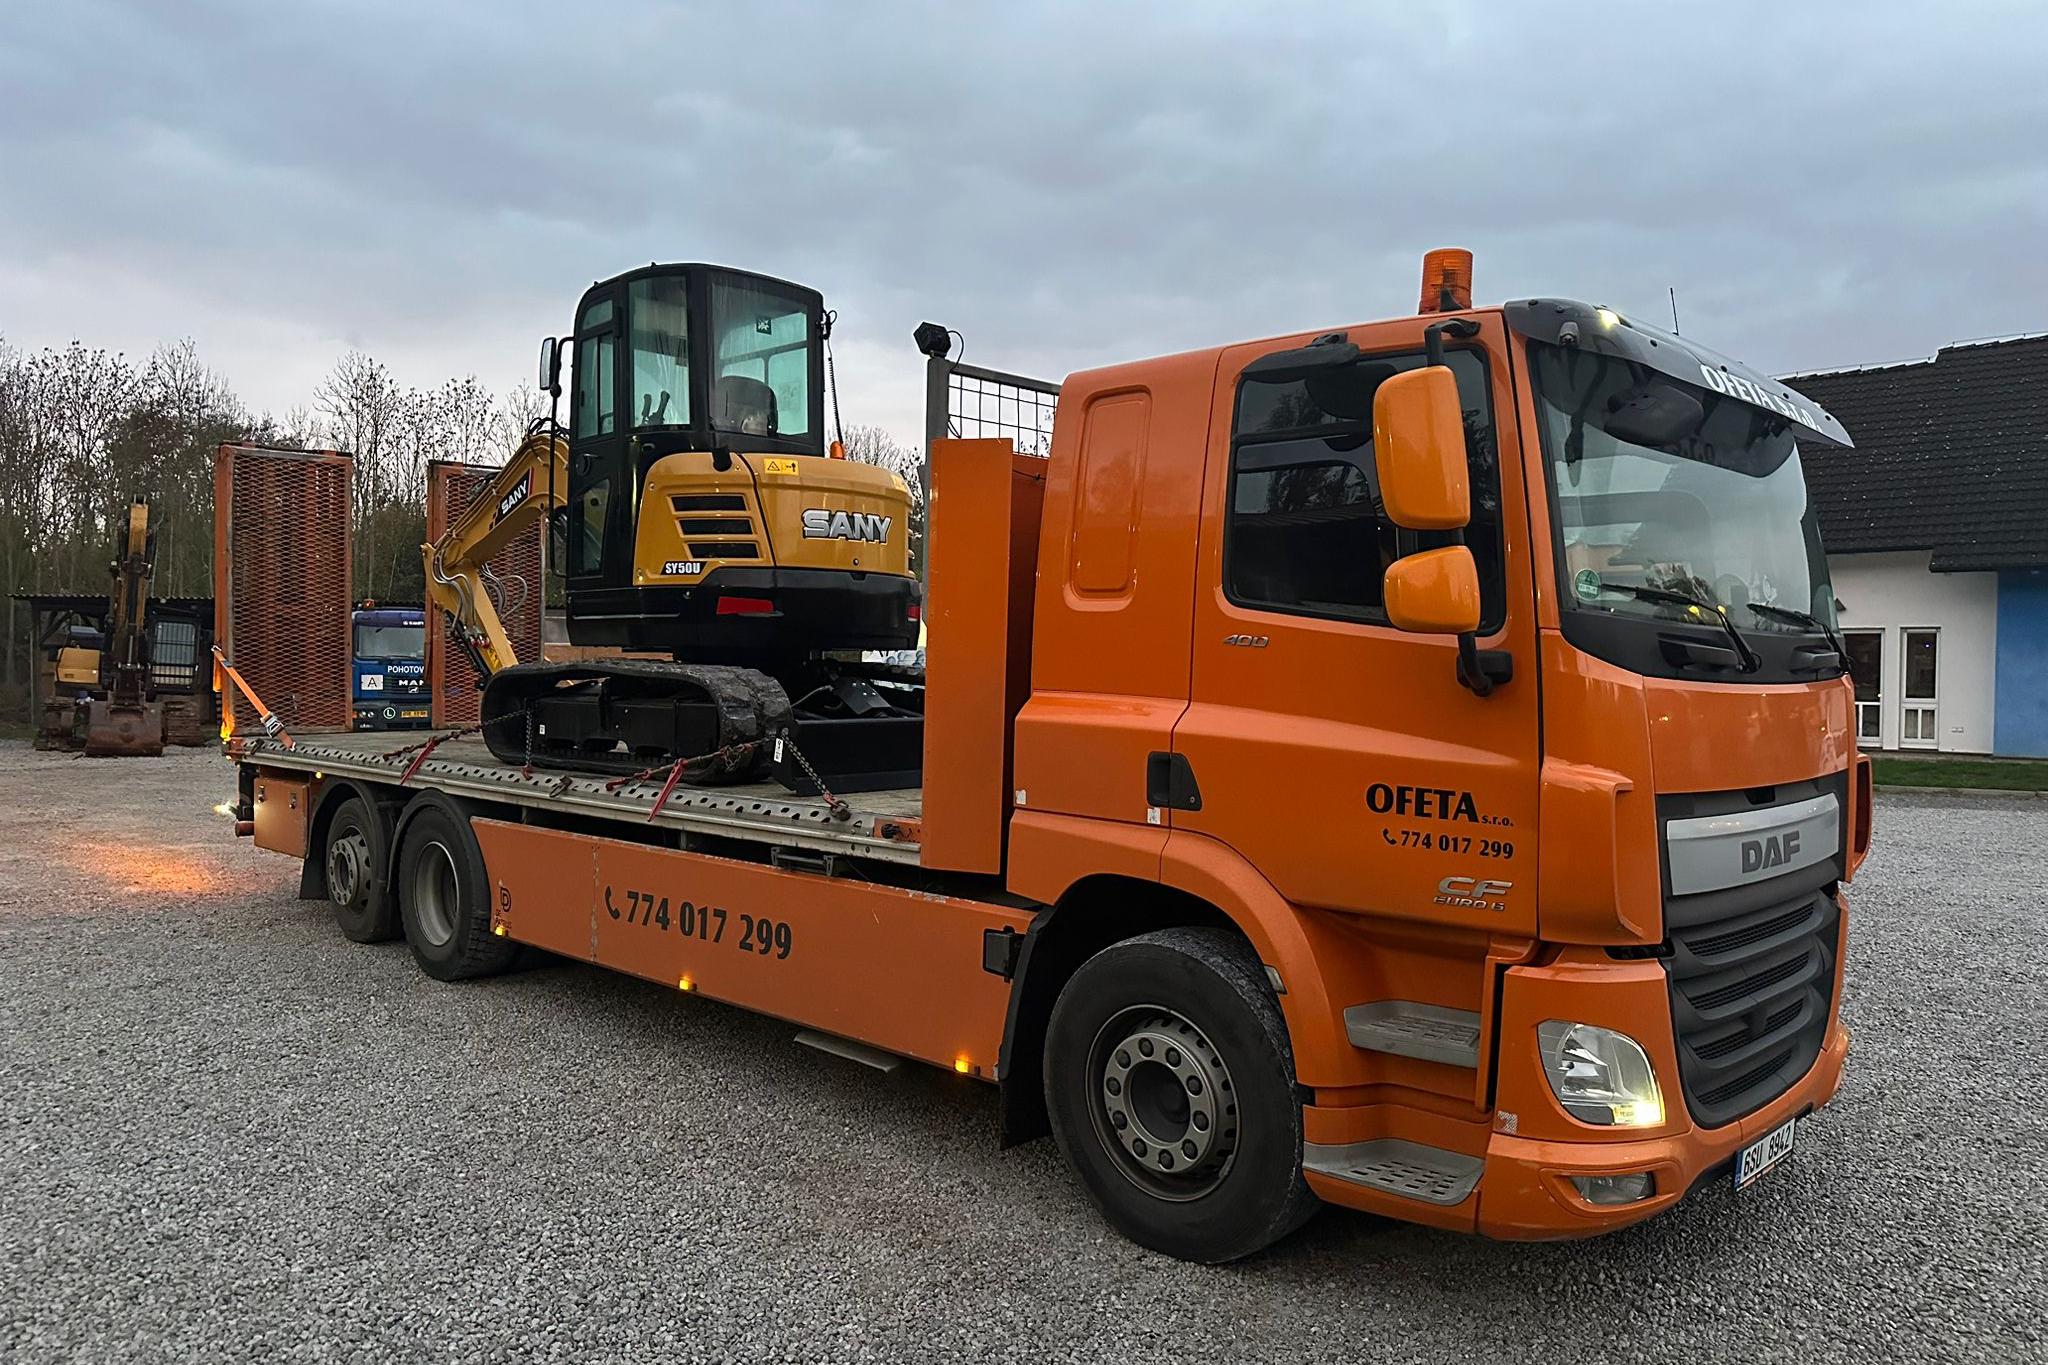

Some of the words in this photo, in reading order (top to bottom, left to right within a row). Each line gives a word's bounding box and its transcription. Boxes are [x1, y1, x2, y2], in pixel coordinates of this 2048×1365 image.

[1700, 364, 1776, 412] OFETA
[501, 479, 527, 514] SANY
[802, 509, 892, 543] SANY
[665, 562, 701, 575] SY50U
[1223, 634, 1269, 647] 400
[367, 677, 377, 687] A
[1365, 783, 1479, 823] OFETA
[1481, 815, 1514, 827] s.r.o.
[1401, 830, 1432, 850] 774
[1439, 834, 1471, 854] 017
[1479, 839, 1514, 860] 299
[1741, 830, 1801, 874] DAF
[1433, 896, 1487, 909] EURO
[1491, 902, 1506, 911] 6
[1438, 876, 1513, 898] CF
[626, 890, 670, 931] 774
[679, 901, 727, 944] 017
[738, 914, 792, 960] 299
[1743, 1142, 1764, 1177] 6SU
